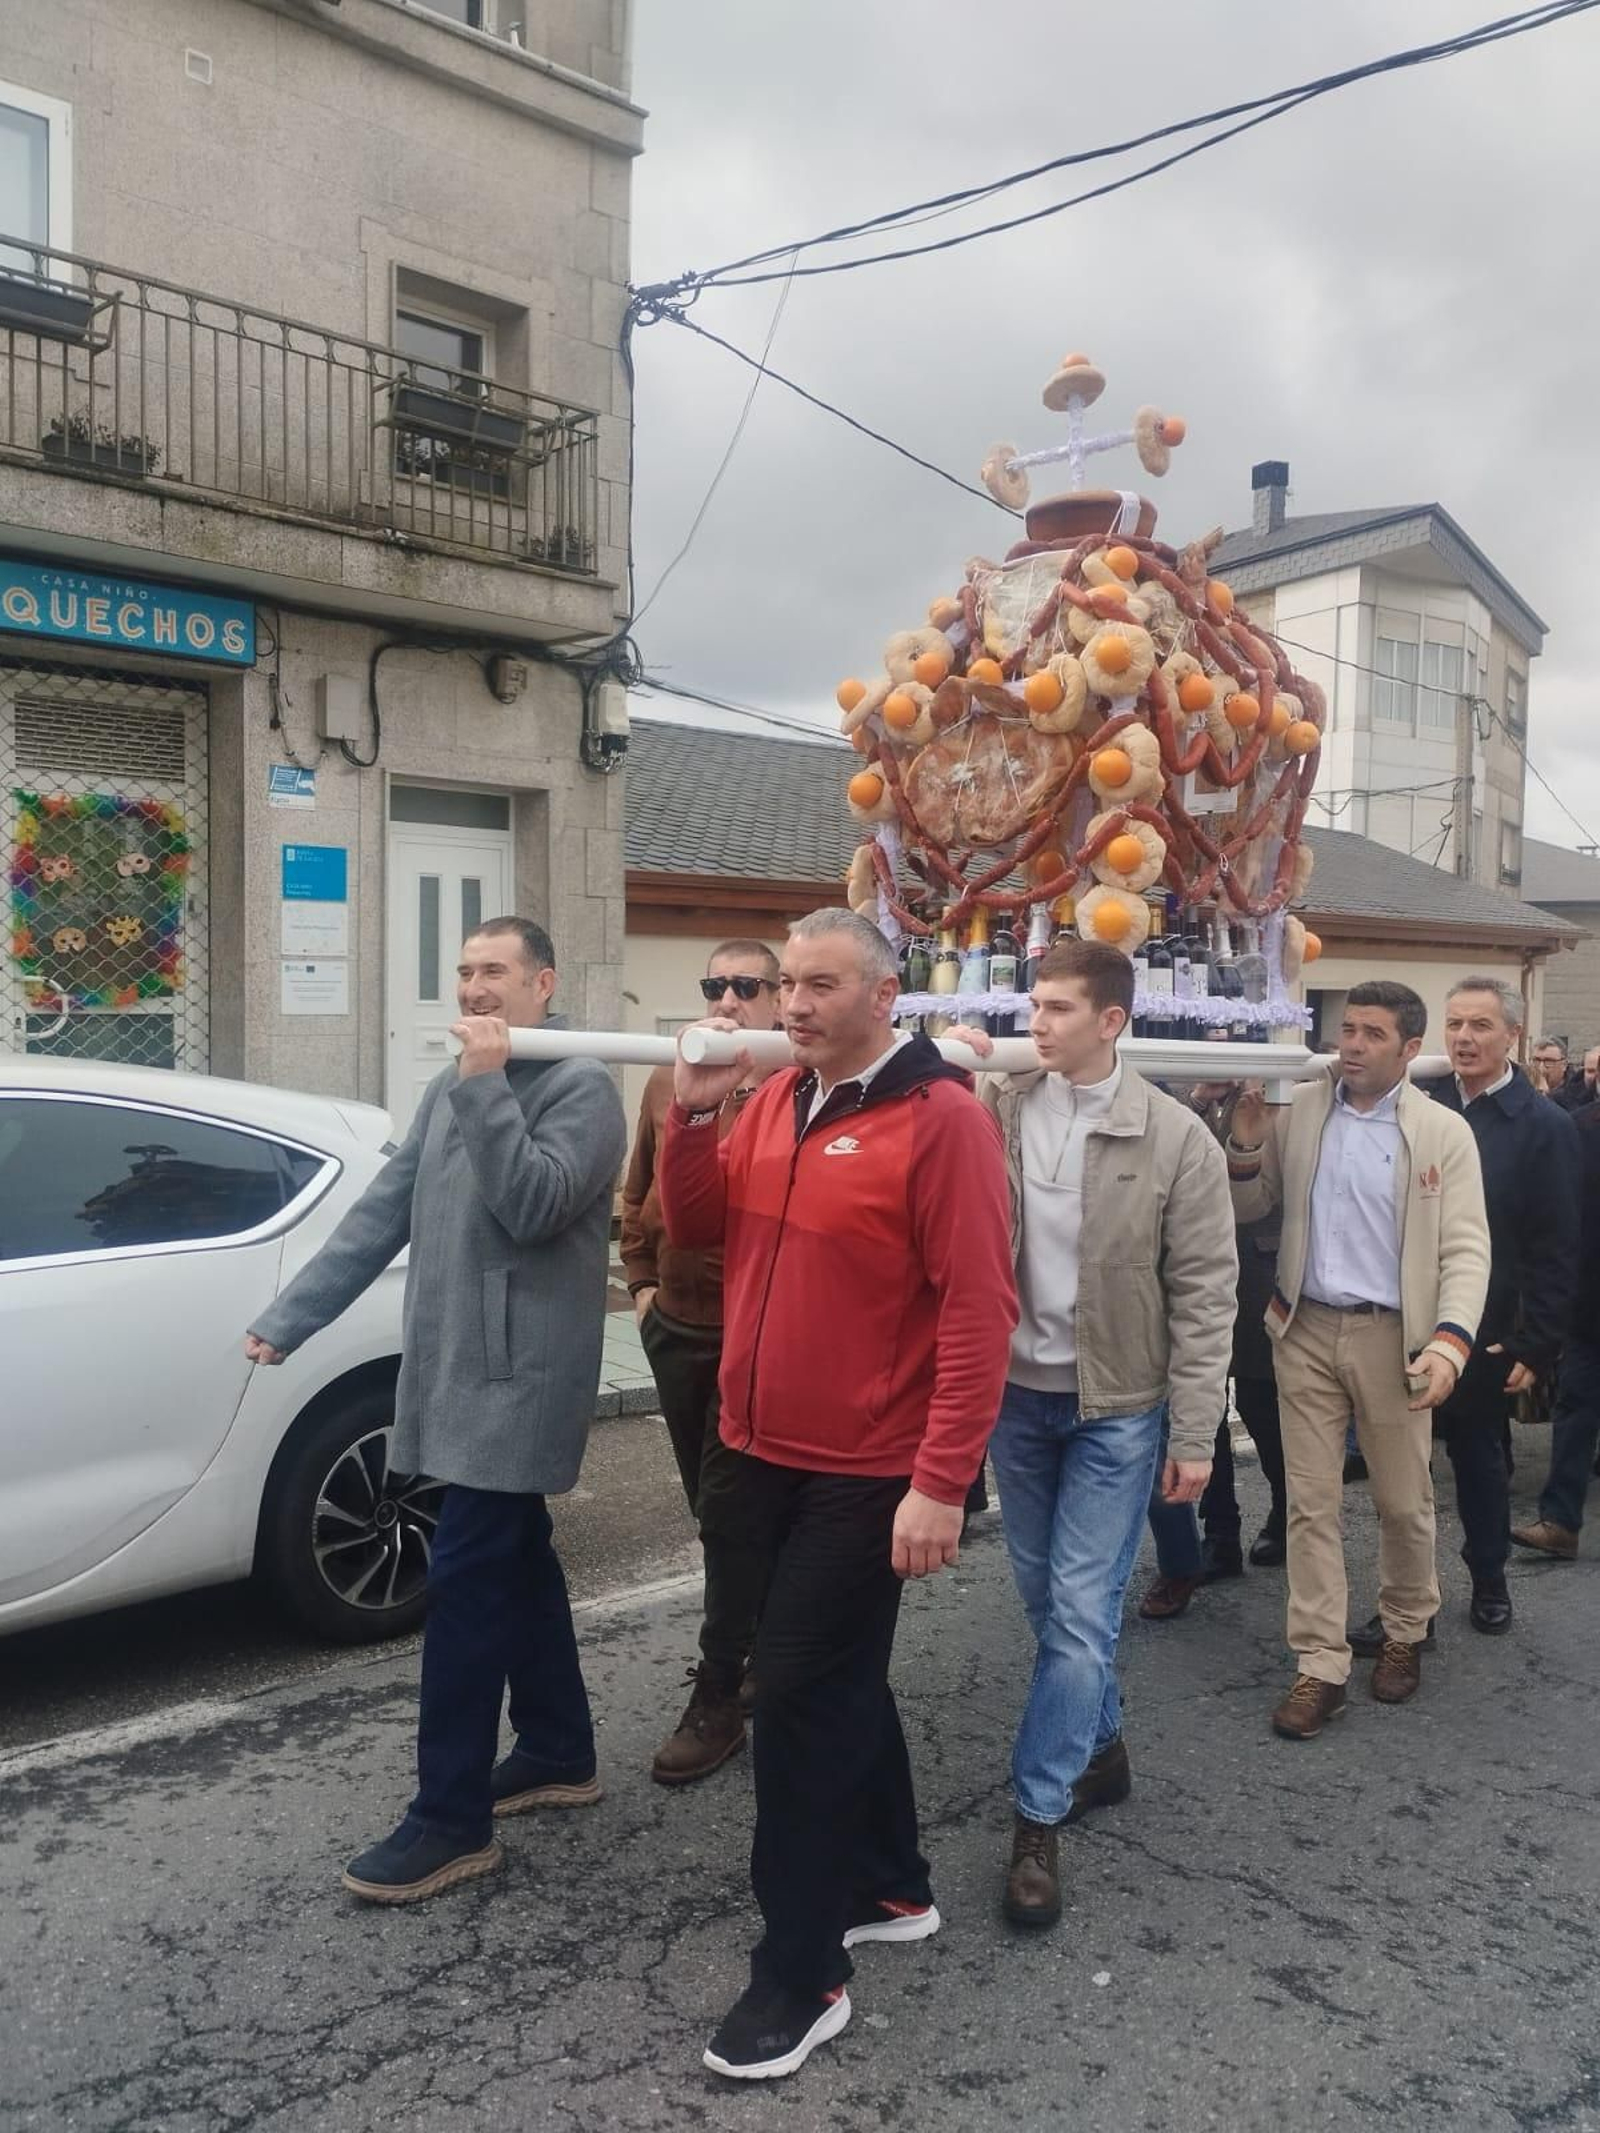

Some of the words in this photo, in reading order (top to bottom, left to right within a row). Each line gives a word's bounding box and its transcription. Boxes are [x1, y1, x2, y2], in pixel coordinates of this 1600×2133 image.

[41, 574, 89, 591] CASA
[102, 584, 149, 600] NIÑO
[2, 586, 246, 655] QUECHOS
